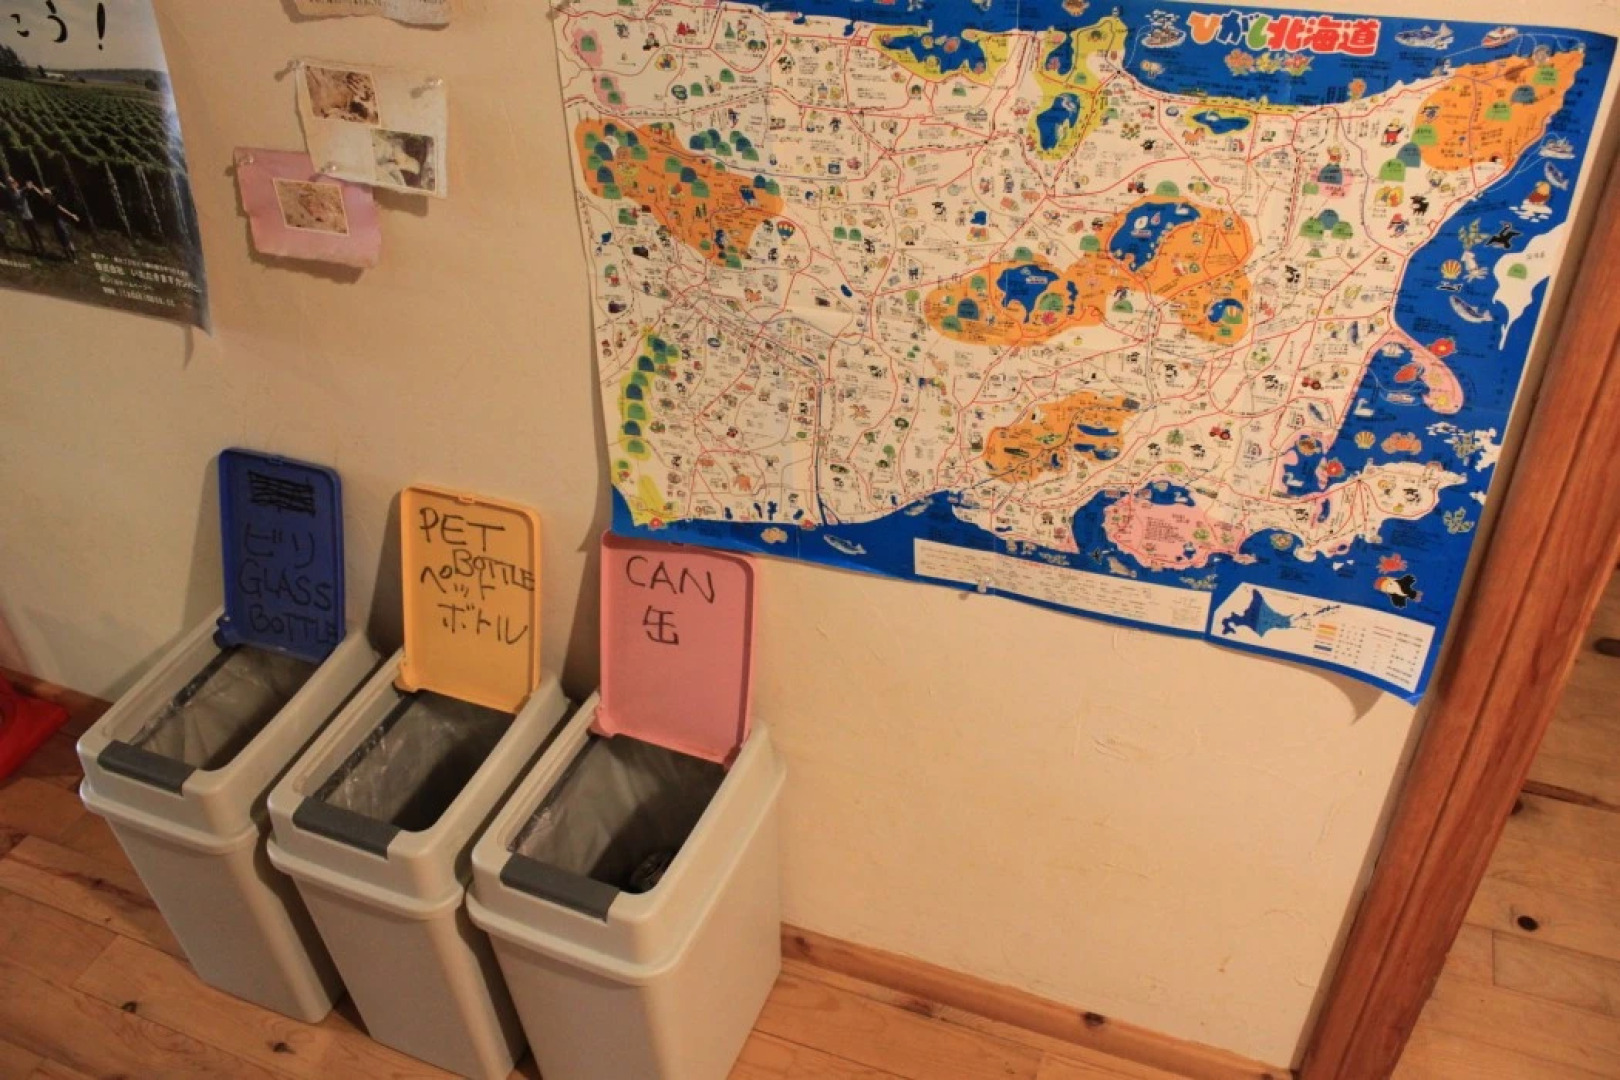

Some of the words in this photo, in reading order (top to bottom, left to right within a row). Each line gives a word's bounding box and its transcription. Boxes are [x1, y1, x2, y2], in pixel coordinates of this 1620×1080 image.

[1187, 9, 1382, 57] ひがし北海道
[419, 506, 506, 552] PET
[238, 558, 332, 612] GLASS
[452, 549, 535, 592] BOTTLE
[626, 555, 715, 604] CAN
[250, 603, 338, 644] BOTTLE
[437, 602, 529, 646] ボトル
[642, 605, 680, 646] 缶
